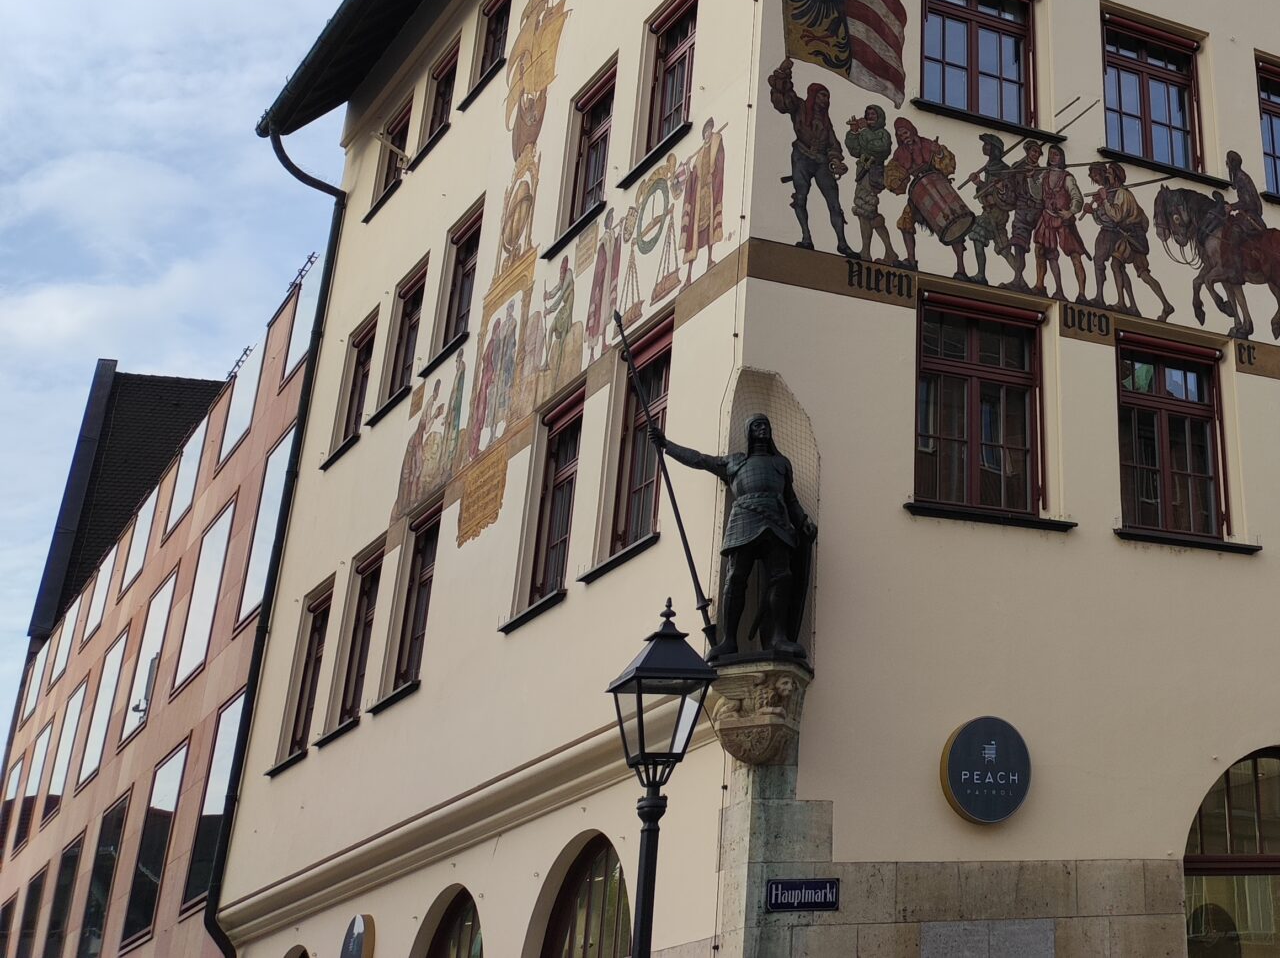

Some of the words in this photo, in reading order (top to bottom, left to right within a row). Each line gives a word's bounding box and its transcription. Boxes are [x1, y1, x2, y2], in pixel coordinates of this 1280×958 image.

[1062, 303, 1110, 336] berg
[1238, 342, 1256, 366] er
[961, 771, 1018, 784] PEACH
[772, 882, 836, 907] Hauptmarkt
